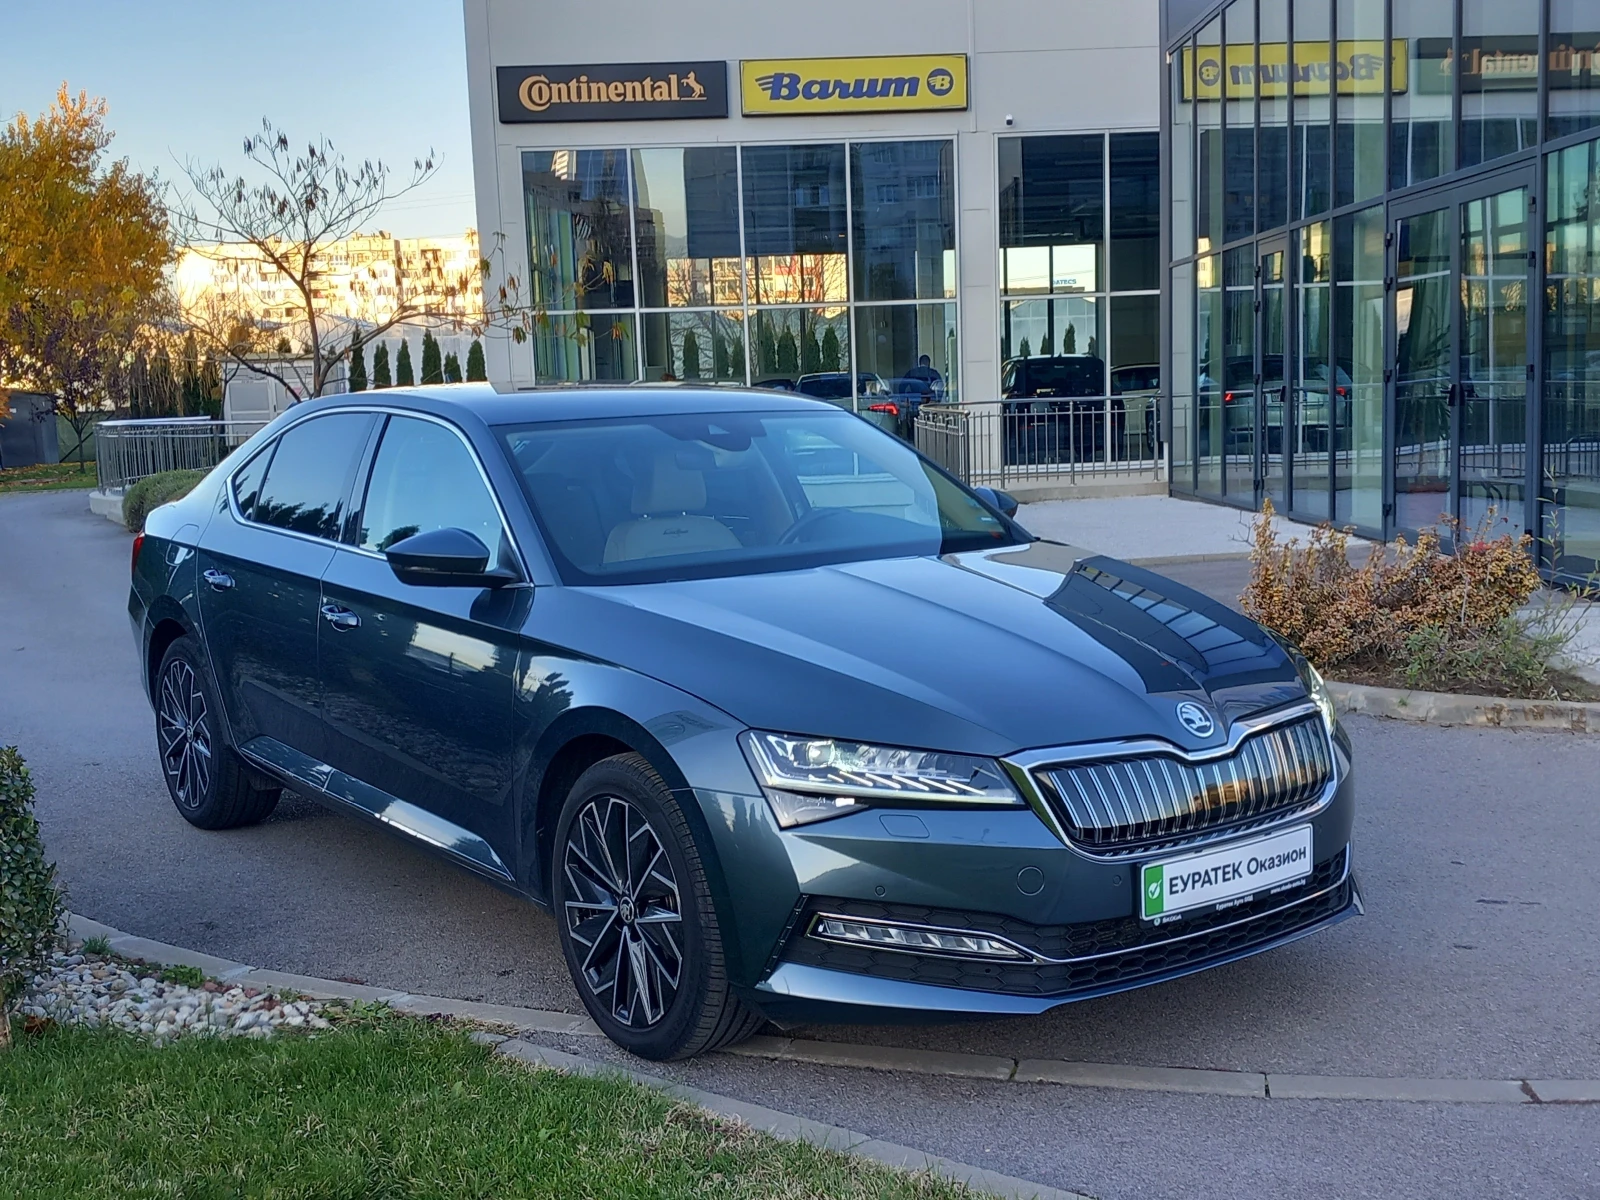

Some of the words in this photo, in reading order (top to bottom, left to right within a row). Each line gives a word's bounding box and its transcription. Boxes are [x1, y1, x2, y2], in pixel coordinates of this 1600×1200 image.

[519, 73, 682, 112] Continental
[755, 72, 920, 101] Barum
[1169, 861, 1243, 895] ЕУРАТЕК
[1247, 846, 1307, 875] Оказион
